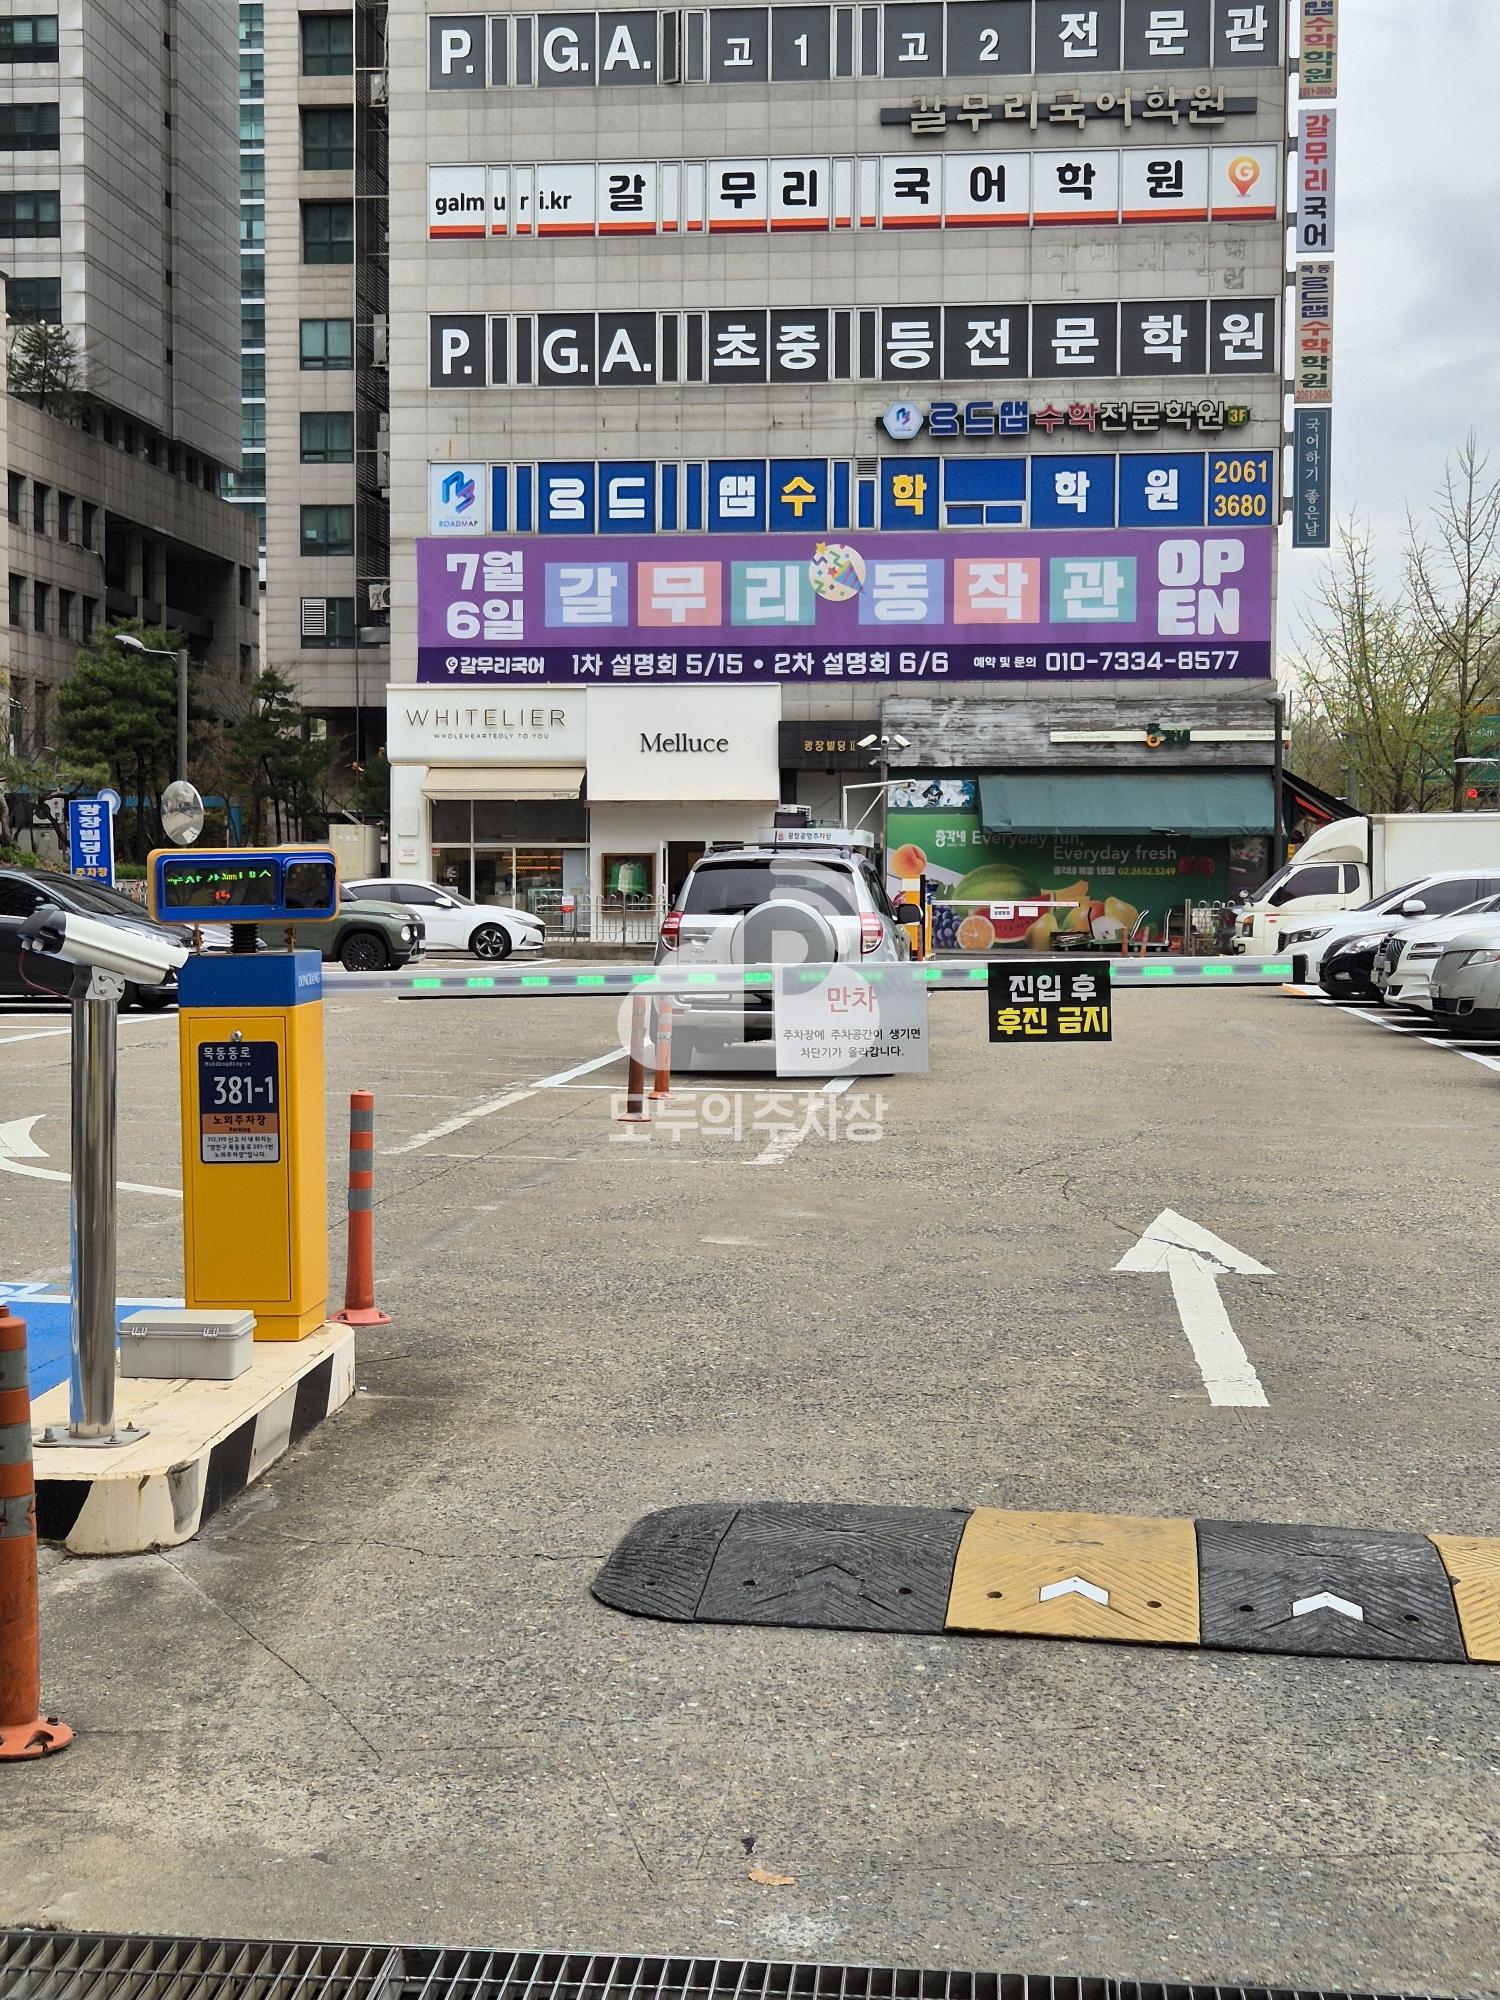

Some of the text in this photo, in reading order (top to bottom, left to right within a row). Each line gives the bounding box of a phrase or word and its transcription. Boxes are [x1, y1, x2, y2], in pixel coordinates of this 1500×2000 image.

[910, 84, 1227, 134] 갈무리국어학원
[1304, 114, 1330, 246] 갈무리국어
[435, 190, 572, 216] galmuri.kr
[1229, 409, 1247, 424] 3F
[1214, 460, 1269, 484] 2061
[1304, 418, 1320, 537] 국어하기 좋은날
[1214, 494, 1267, 517] 3680
[438, 519, 479, 528] ROADMAP
[446, 551, 524, 593] 7월
[1158, 538, 1245, 587] OP
[446, 599, 524, 641] 6일
[1157, 587, 1240, 636] EN
[460, 650, 1240, 677] 갈무리국어 1차 설명회 5/15 2차 설명회 6/6 예약 및 문의 010-7334-8577
[406, 709, 566, 727] WHITELIER
[640, 732, 729, 753] Melluce
[972, 831, 1048, 849] Everyday
[1053, 844, 1177, 863] Everyday fresh
[827, 985, 877, 1013] 만차
[1008, 974, 1097, 1003] 진입 후
[997, 1006, 1108, 1035] 후진 금지
[783, 1027, 921, 1041] 주차장에 주차공간이 생기면
[203, 1046, 251, 1060] 목동동로
[800, 1046, 905, 1059] 차단기가 올라갑니다.
[213, 1075, 274, 1105] 381-1
[213, 1115, 266, 1126] 노외주차장
